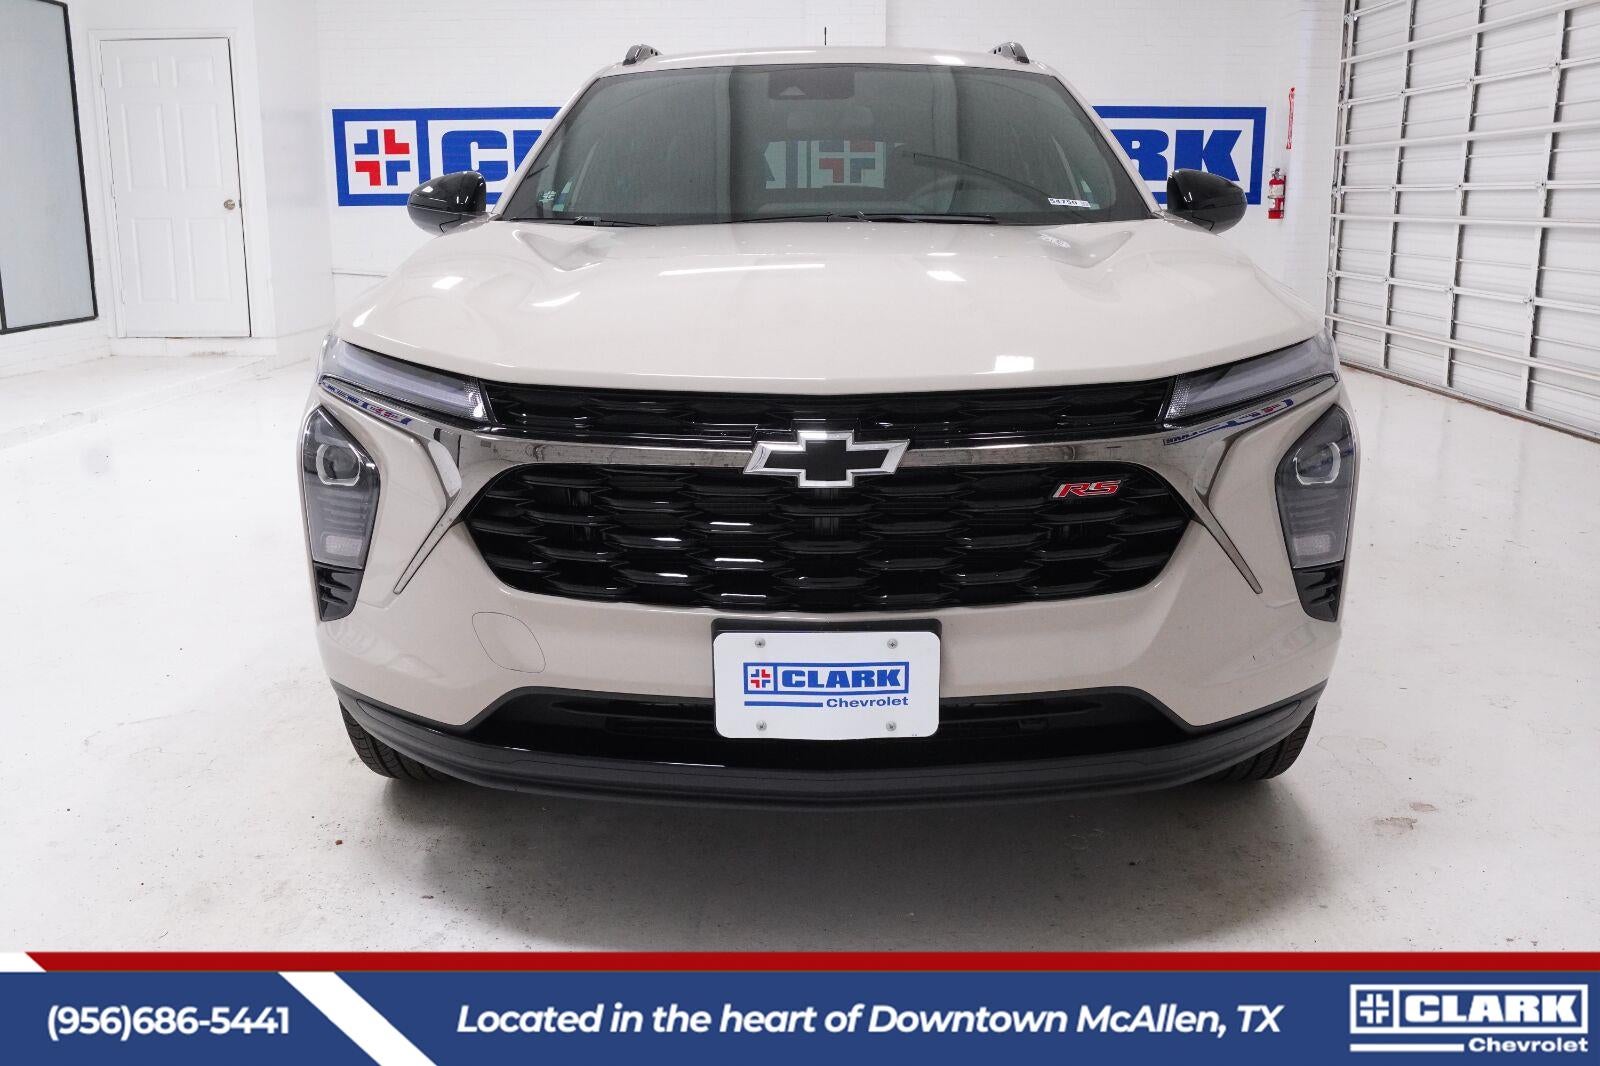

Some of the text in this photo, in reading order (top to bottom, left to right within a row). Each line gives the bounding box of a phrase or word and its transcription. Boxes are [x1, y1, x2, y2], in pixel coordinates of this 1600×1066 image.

[1052, 480, 1121, 497] RS
[782, 669, 901, 689] CLARK
[826, 696, 909, 709] Chevrolet
